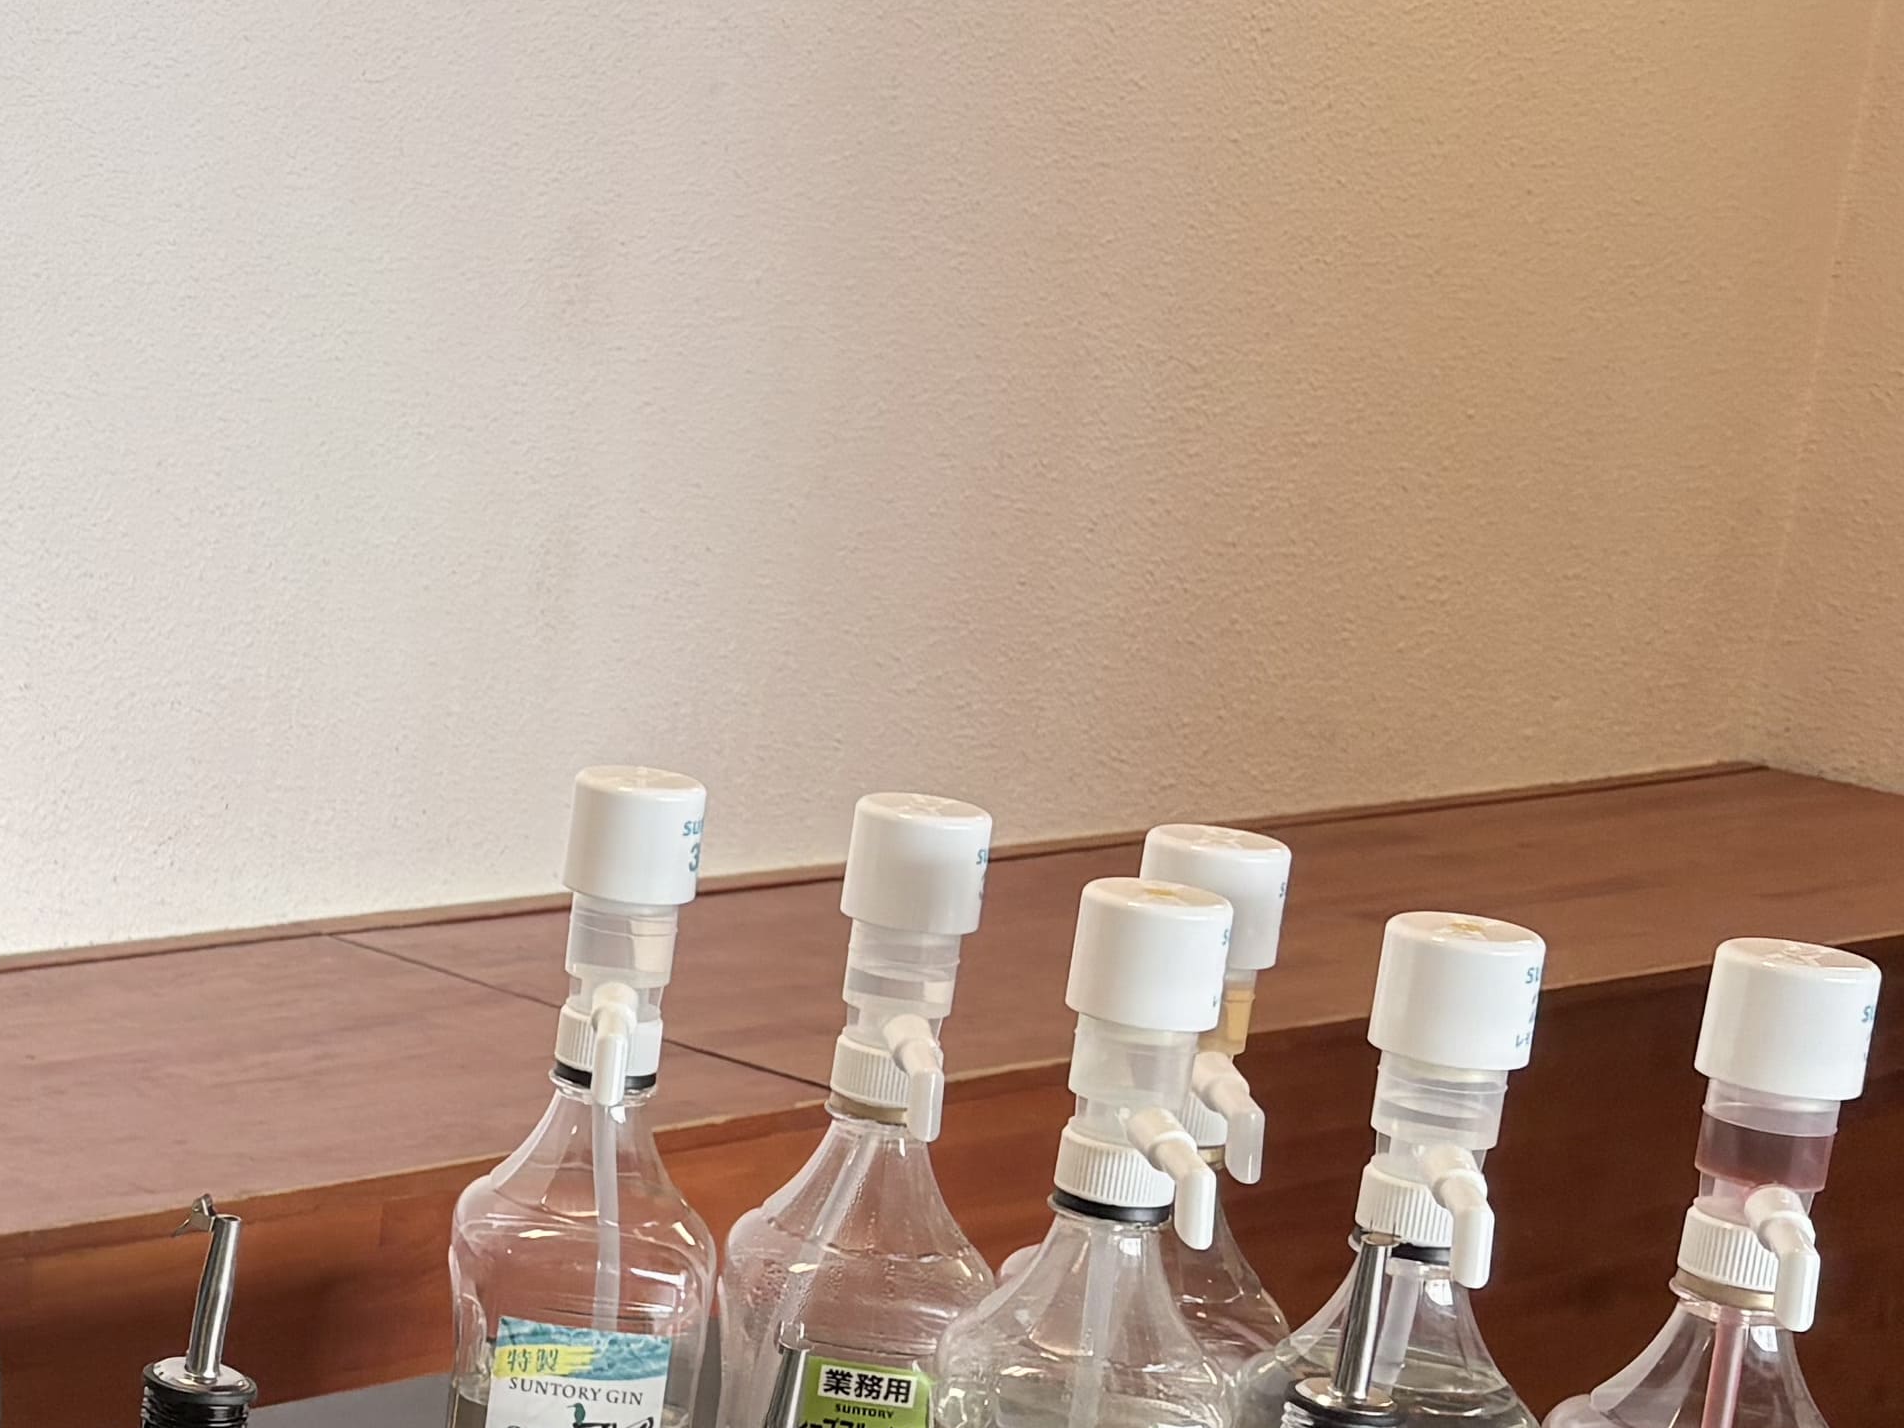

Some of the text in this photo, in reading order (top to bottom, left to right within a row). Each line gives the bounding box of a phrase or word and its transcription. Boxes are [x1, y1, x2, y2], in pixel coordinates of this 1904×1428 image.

[506, 1347, 560, 1373] 特製
[508, 1376, 644, 1406] SUNTORY GIN
[823, 1369, 911, 1404] 業務用
[835, 1403, 894, 1419] SUNTORY
